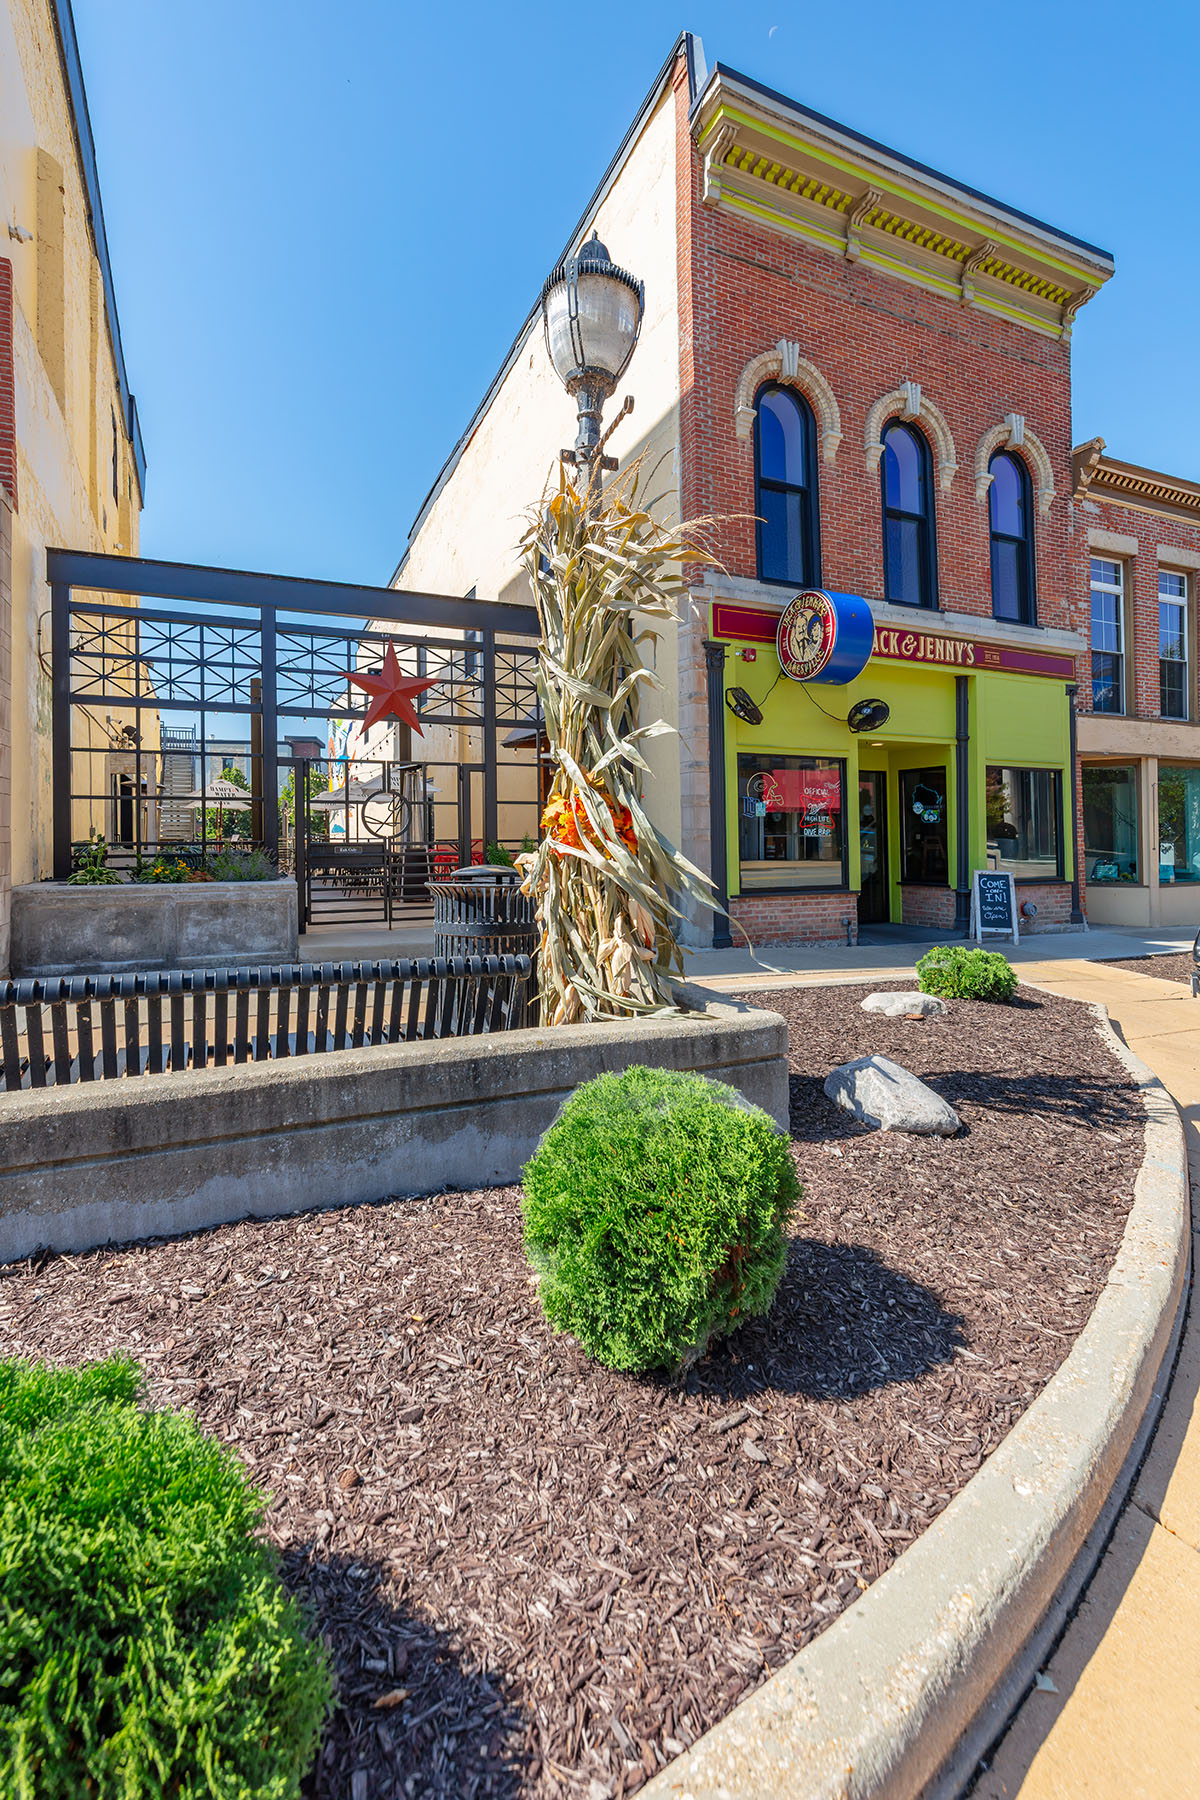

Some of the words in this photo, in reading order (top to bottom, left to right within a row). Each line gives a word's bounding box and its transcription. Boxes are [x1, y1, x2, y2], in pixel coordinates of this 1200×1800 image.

[872, 629, 899, 654] ACK
[901, 634, 917, 656] &
[916, 636, 975, 665] JENNY'S
[803, 828, 817, 836] DIVE
[985, 892, 1007, 903] IN!
